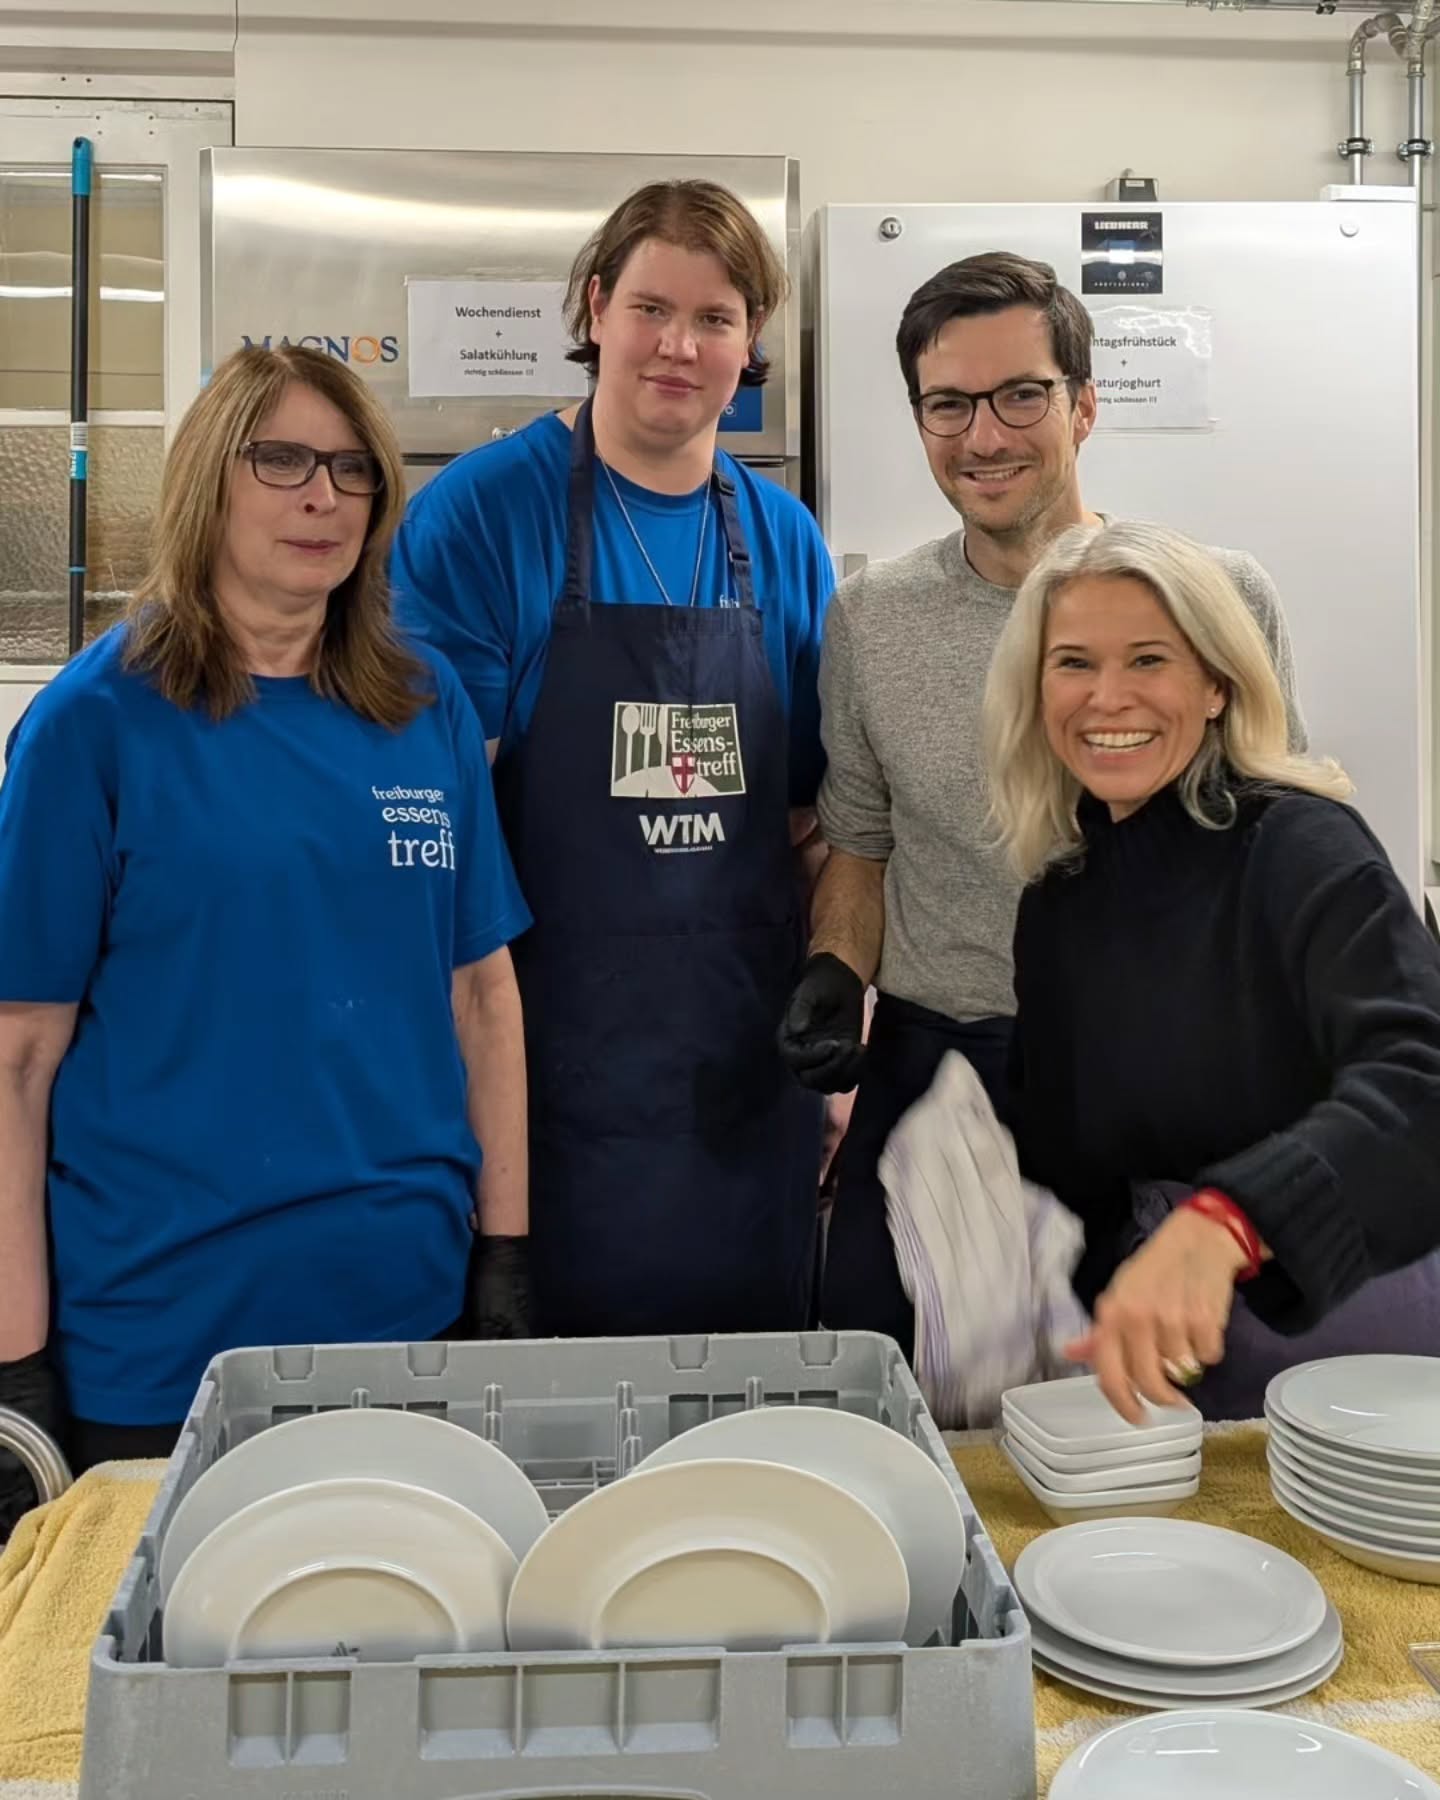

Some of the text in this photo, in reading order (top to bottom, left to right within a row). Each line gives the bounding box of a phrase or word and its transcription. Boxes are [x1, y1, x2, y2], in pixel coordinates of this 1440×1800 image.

[455, 306, 541, 318] Wochendienst
[1093, 336, 1176, 349] ntagsfrühstück
[459, 349, 538, 363] Salatkühlung
[1093, 377, 1161, 390] aturjoghurt
[671, 730, 734, 754] Essens-
[696, 751, 737, 777] treff
[381, 805, 451, 829] essens
[638, 812, 726, 845] WTM
[387, 828, 456, 870] treff
